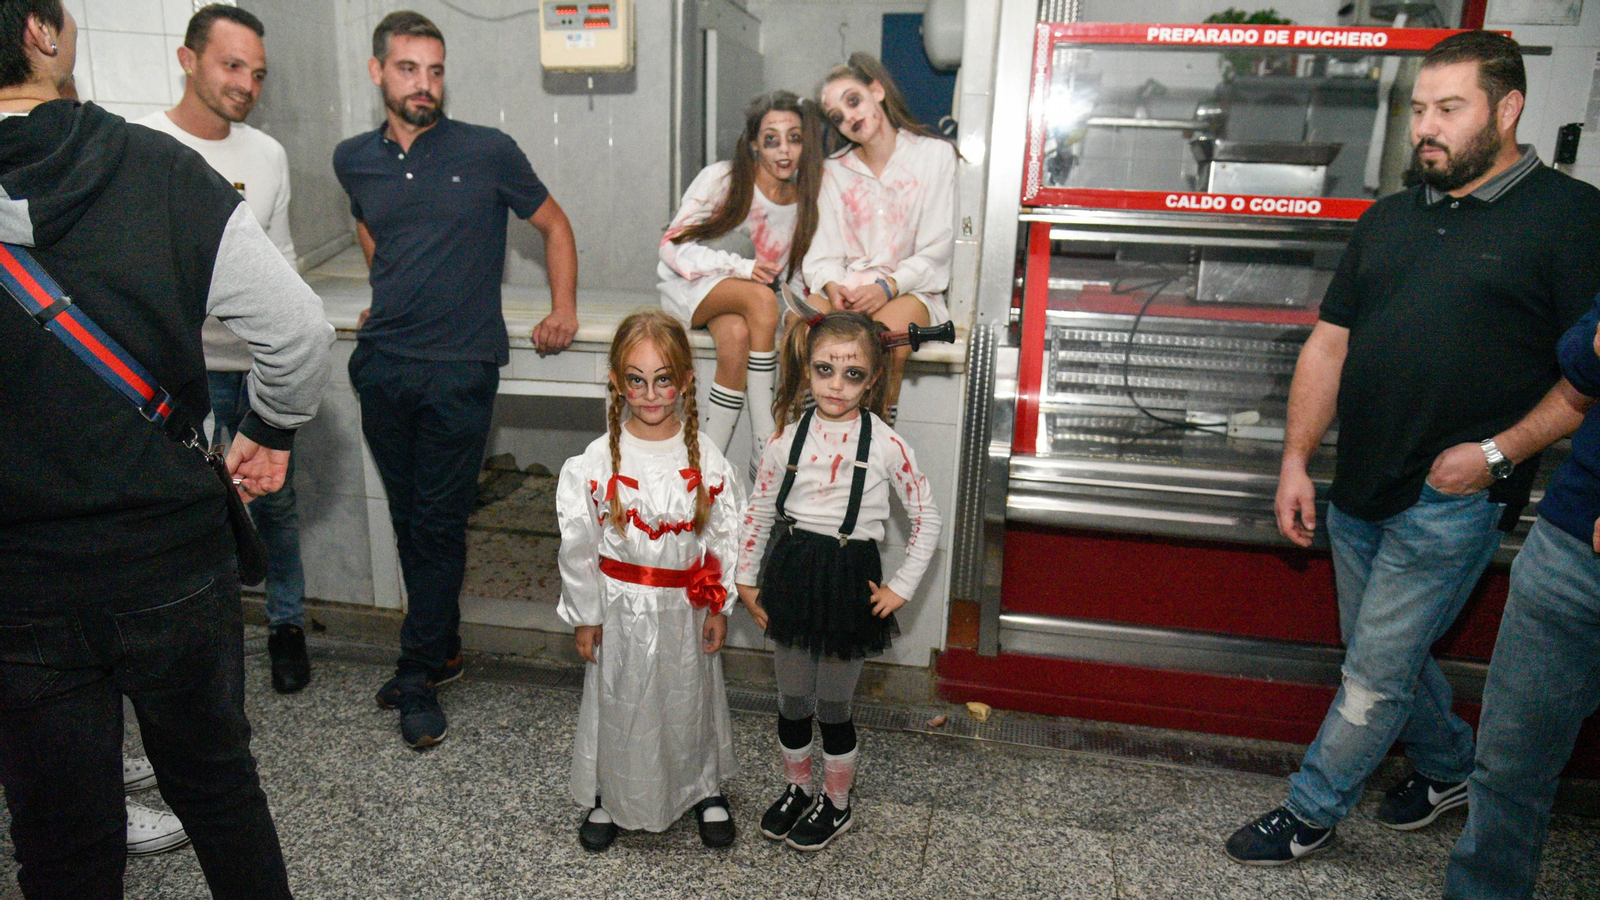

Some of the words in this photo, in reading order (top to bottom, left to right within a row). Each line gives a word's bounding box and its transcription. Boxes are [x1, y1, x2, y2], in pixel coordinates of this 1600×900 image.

[1147, 27, 1259, 43] PREPARADO
[1263, 29, 1290, 44] DE
[1294, 30, 1388, 47] PUCHERO
[1165, 194, 1226, 210] CALDO
[1231, 197, 1245, 210] O
[1249, 197, 1321, 214] COCIDO
